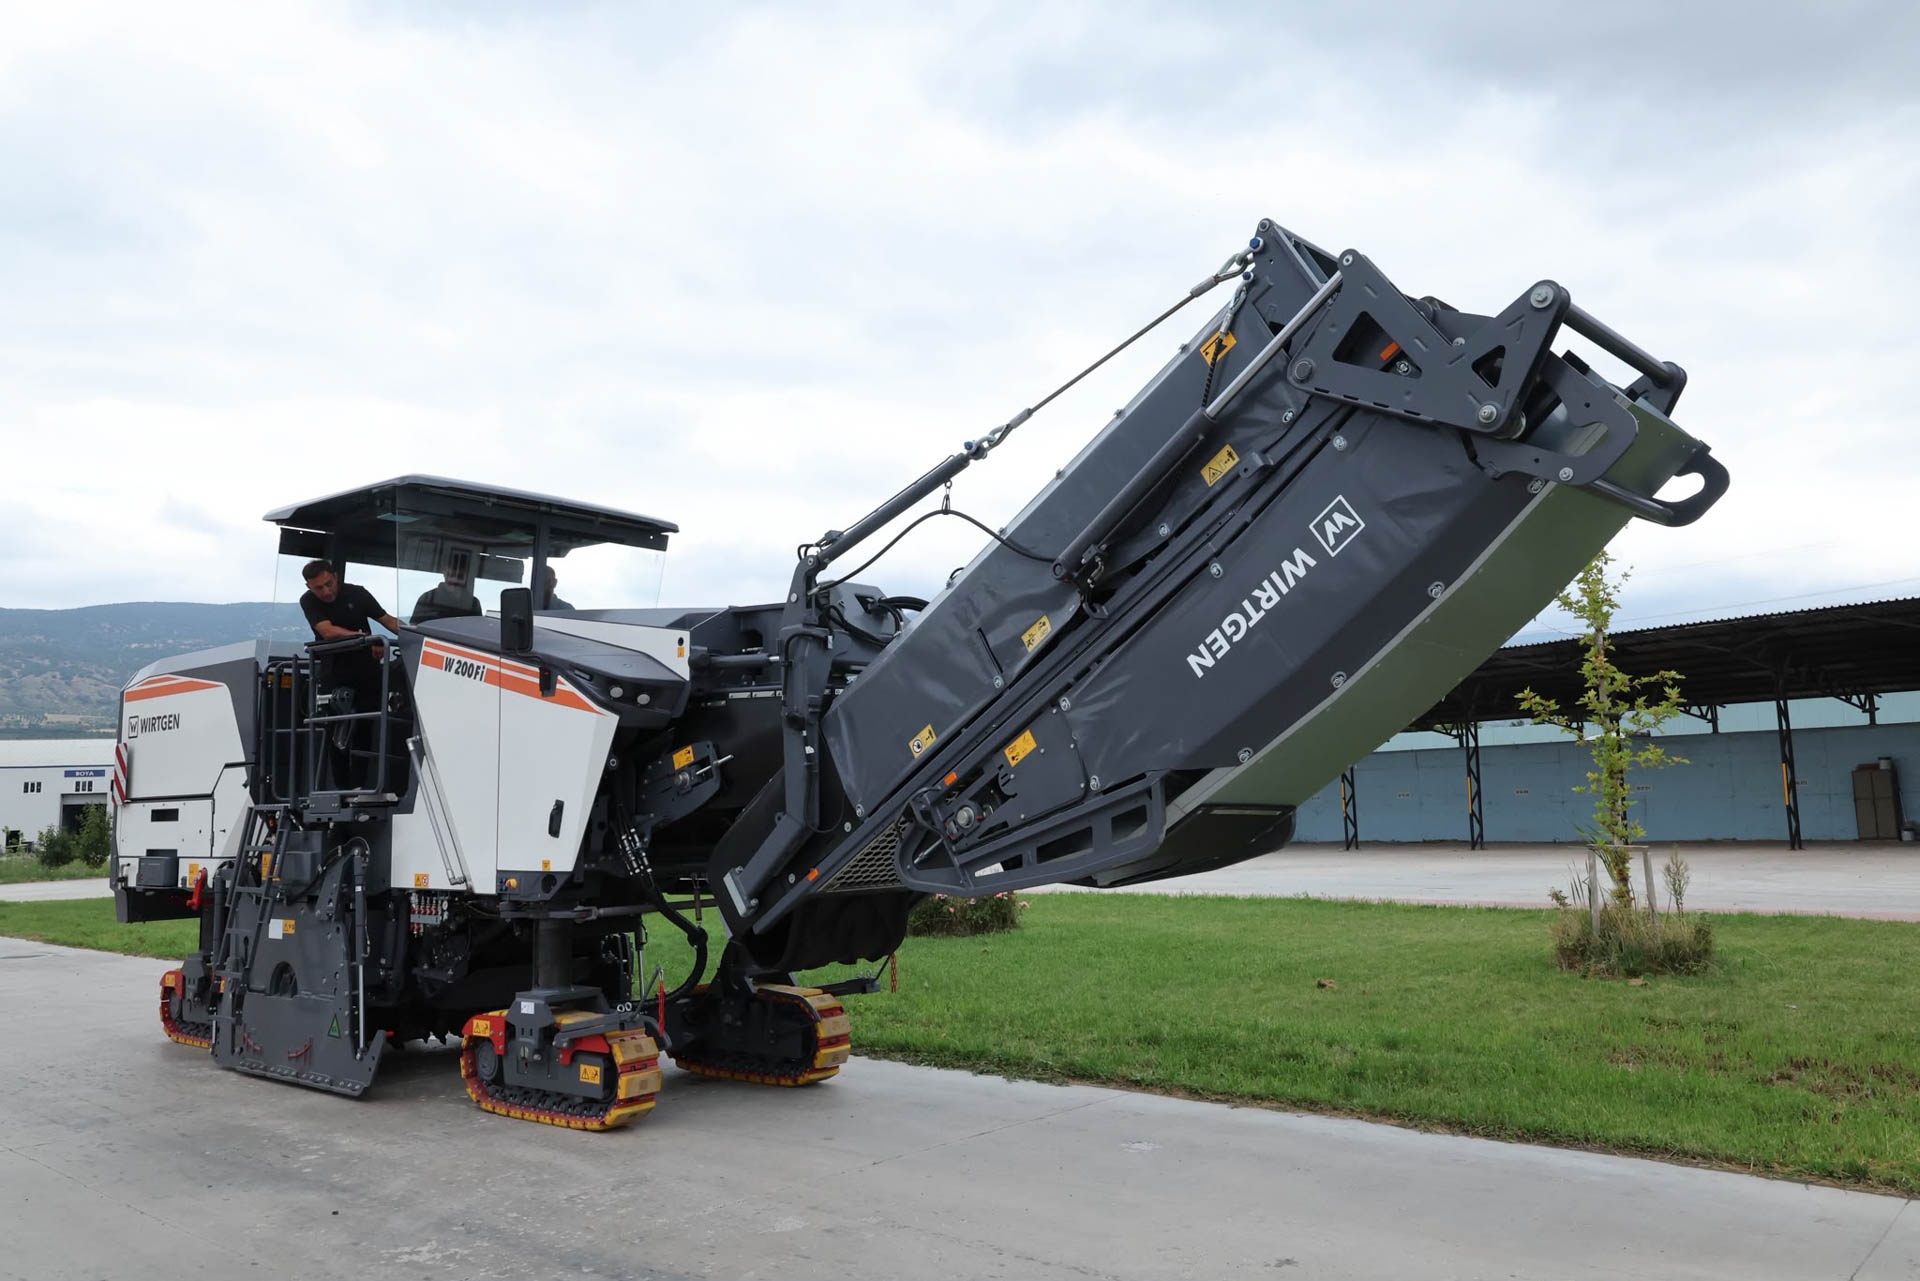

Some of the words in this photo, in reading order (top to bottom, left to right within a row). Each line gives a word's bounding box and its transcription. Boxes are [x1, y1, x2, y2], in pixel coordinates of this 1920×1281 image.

[1186, 547, 1317, 679] WIRTGEN
[444, 656, 455, 672] W
[454, 660, 485, 681] 200Fi
[140, 713, 180, 734] WIRTGEN
